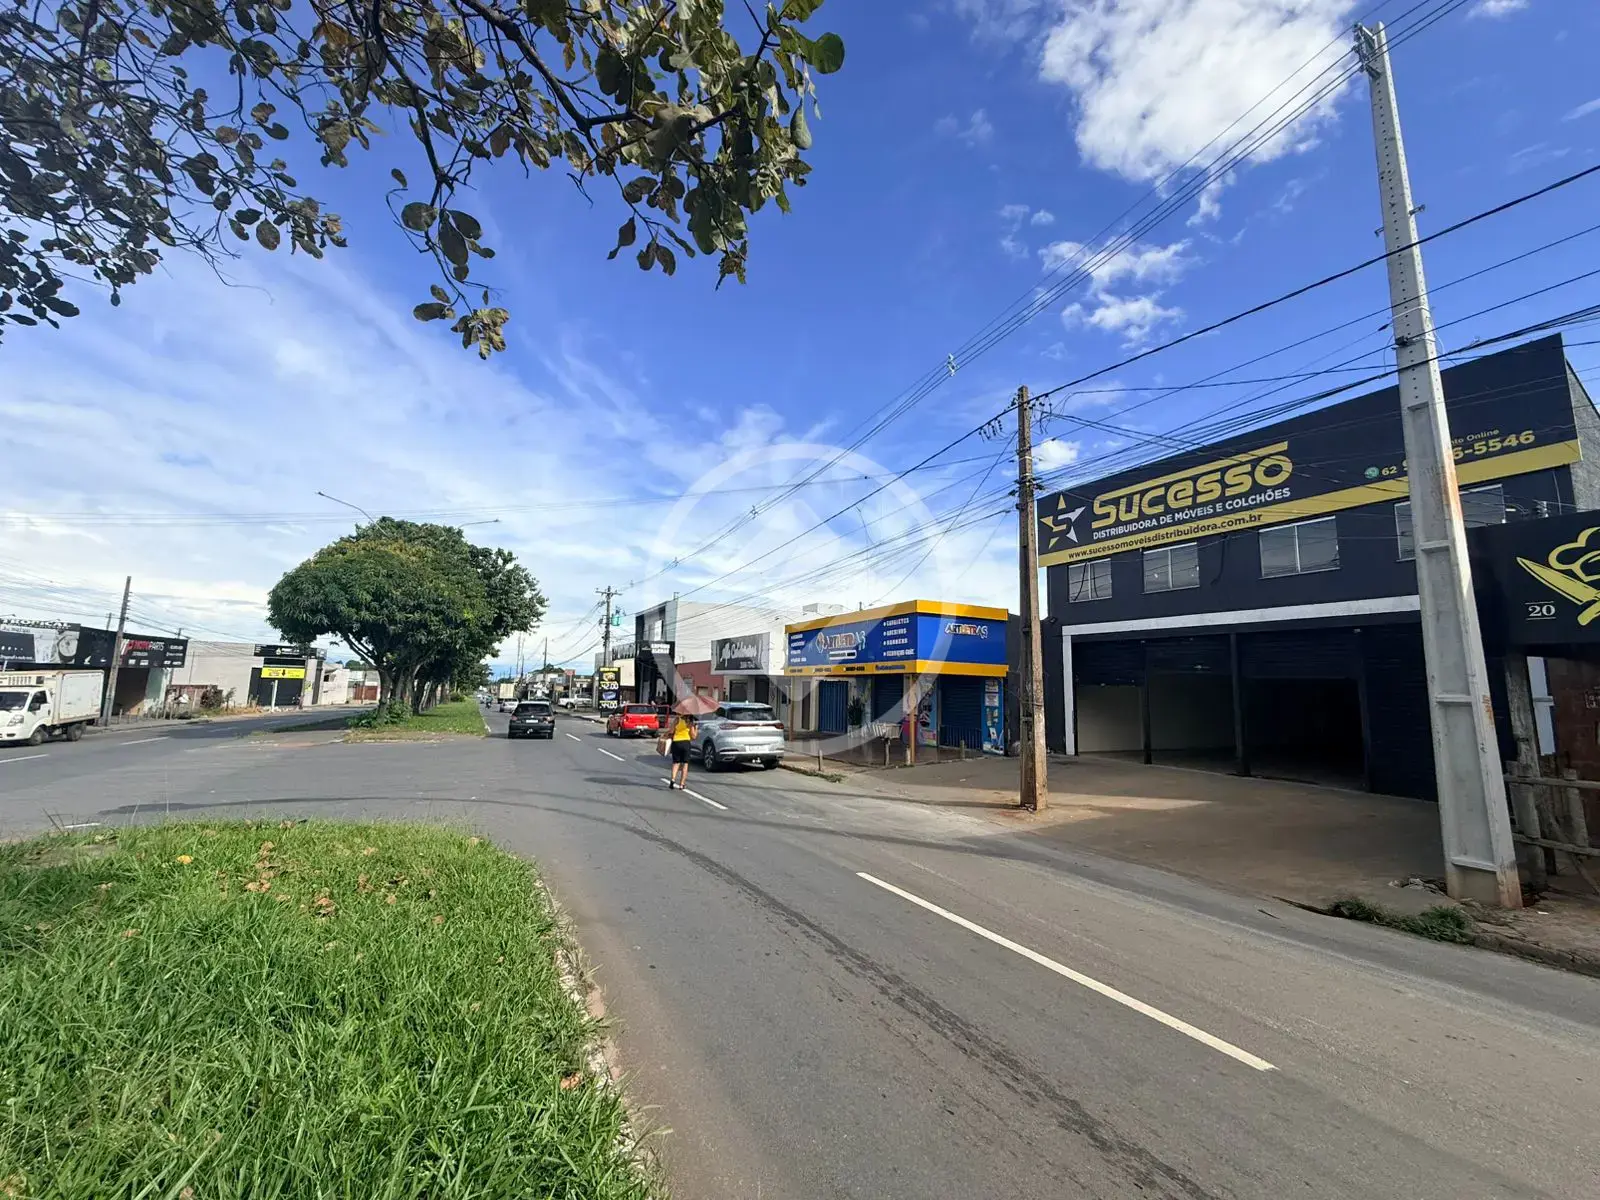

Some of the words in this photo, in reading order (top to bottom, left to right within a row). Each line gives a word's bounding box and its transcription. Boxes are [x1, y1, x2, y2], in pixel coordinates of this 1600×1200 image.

[1381, 465, 1398, 476] 62
[1452, 430, 1535, 460] 6-5546
[1466, 429, 1500, 441] Online
[1068, 512, 1263, 559] www.sucessomoveisdistribuidora.com.br
[1092, 519, 1157, 540] DISTRIBUIDORA
[1160, 514, 1173, 525] DE
[1174, 504, 1214, 522] MÓVEIS
[1216, 502, 1223, 512] E
[1226, 487, 1291, 510] COLCHÕES
[1528, 604, 1556, 617] 20
